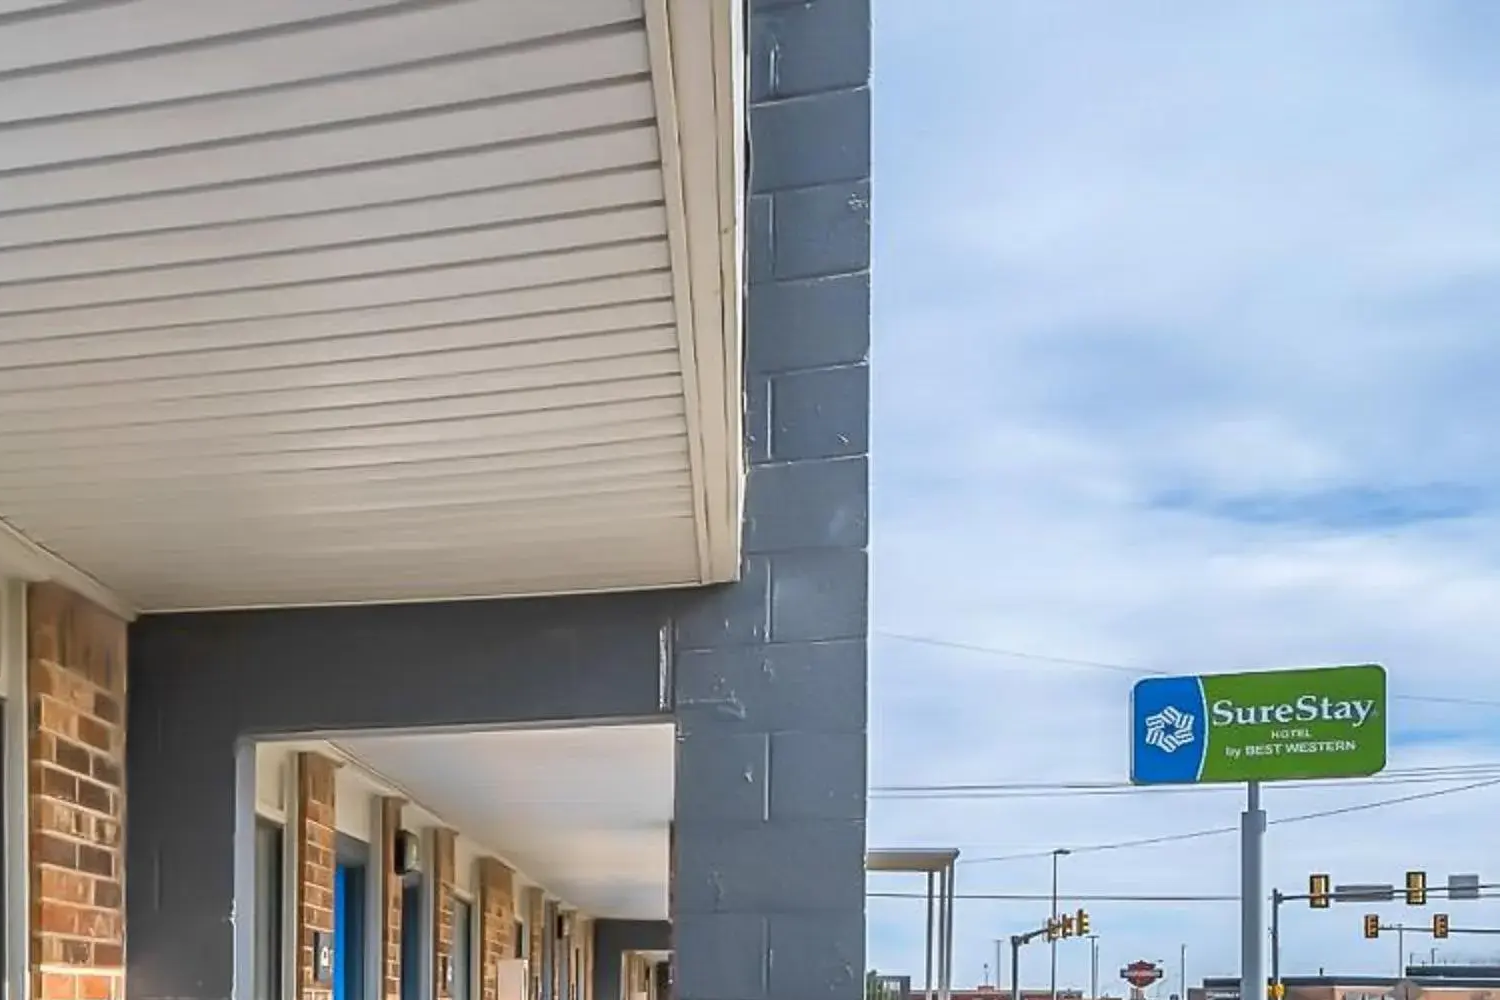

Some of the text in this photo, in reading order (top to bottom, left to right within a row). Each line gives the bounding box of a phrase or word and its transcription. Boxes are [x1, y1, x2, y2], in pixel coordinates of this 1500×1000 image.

[1212, 695, 1375, 727] SureStay
[1272, 729, 1311, 739] HOTEL
[1225, 740, 1357, 759] by BEST WESTERN
